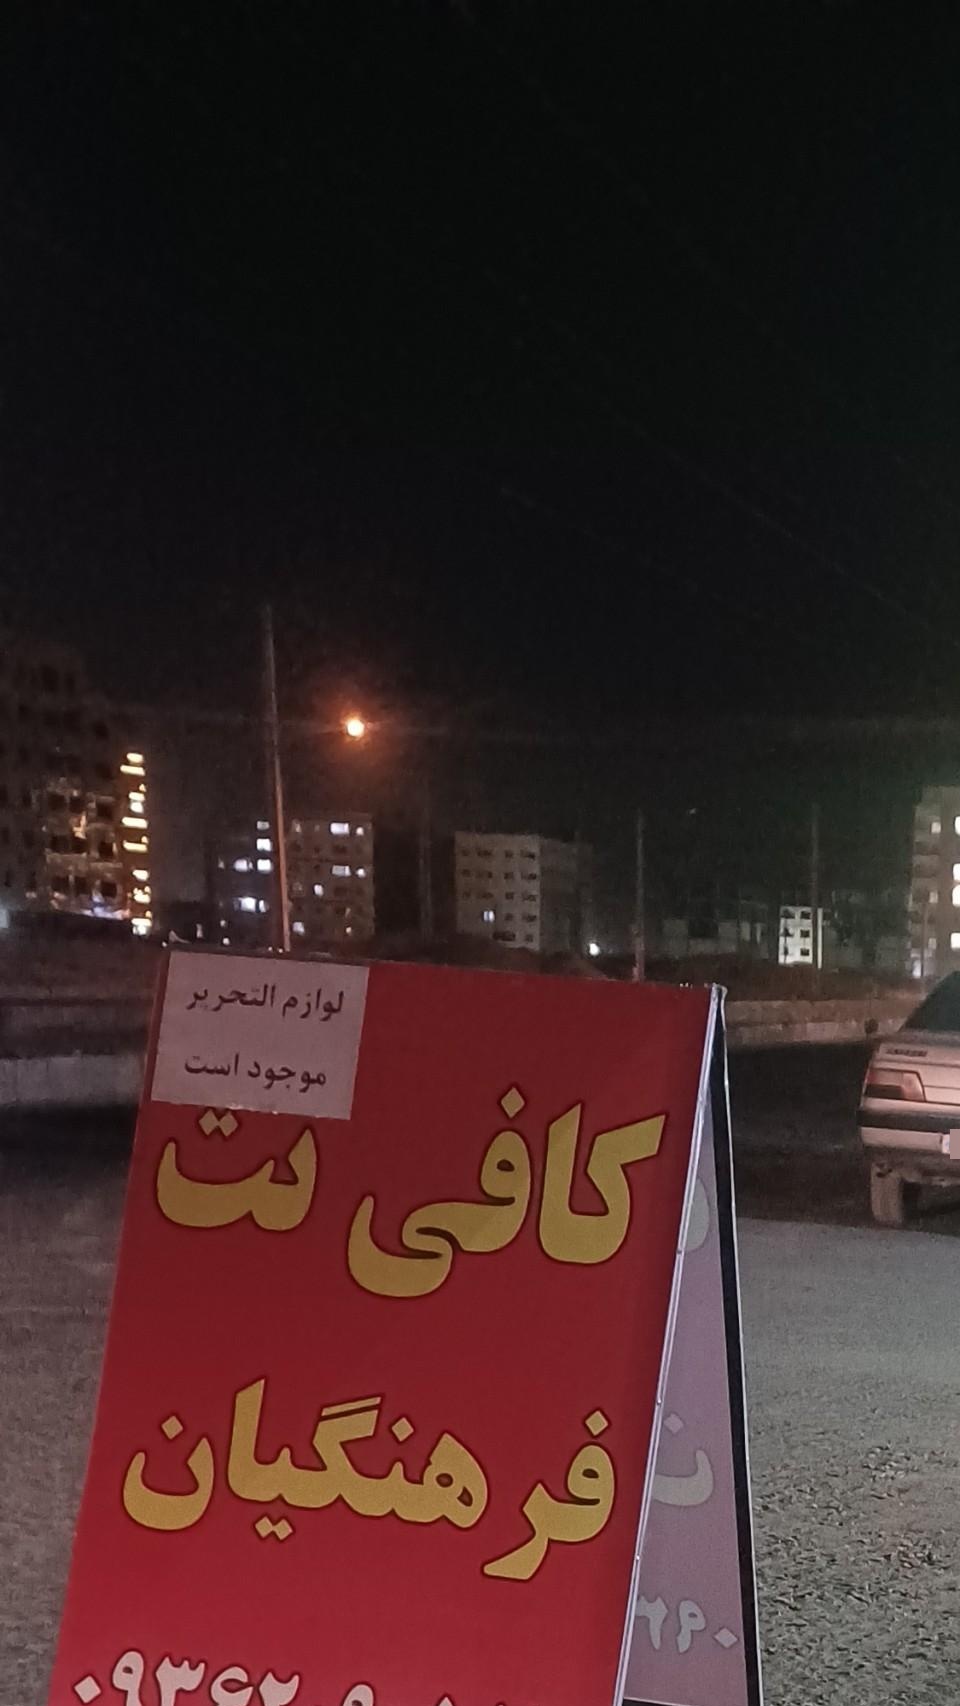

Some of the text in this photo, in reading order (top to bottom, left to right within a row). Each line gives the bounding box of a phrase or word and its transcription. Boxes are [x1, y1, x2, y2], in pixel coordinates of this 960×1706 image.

[186, 983, 344, 1022] لوازم التحریر
[184, 1053, 327, 1093] موجود است
[347, 1086, 667, 1299] کافی
[122, 1377, 616, 1581] فرهنگیان
